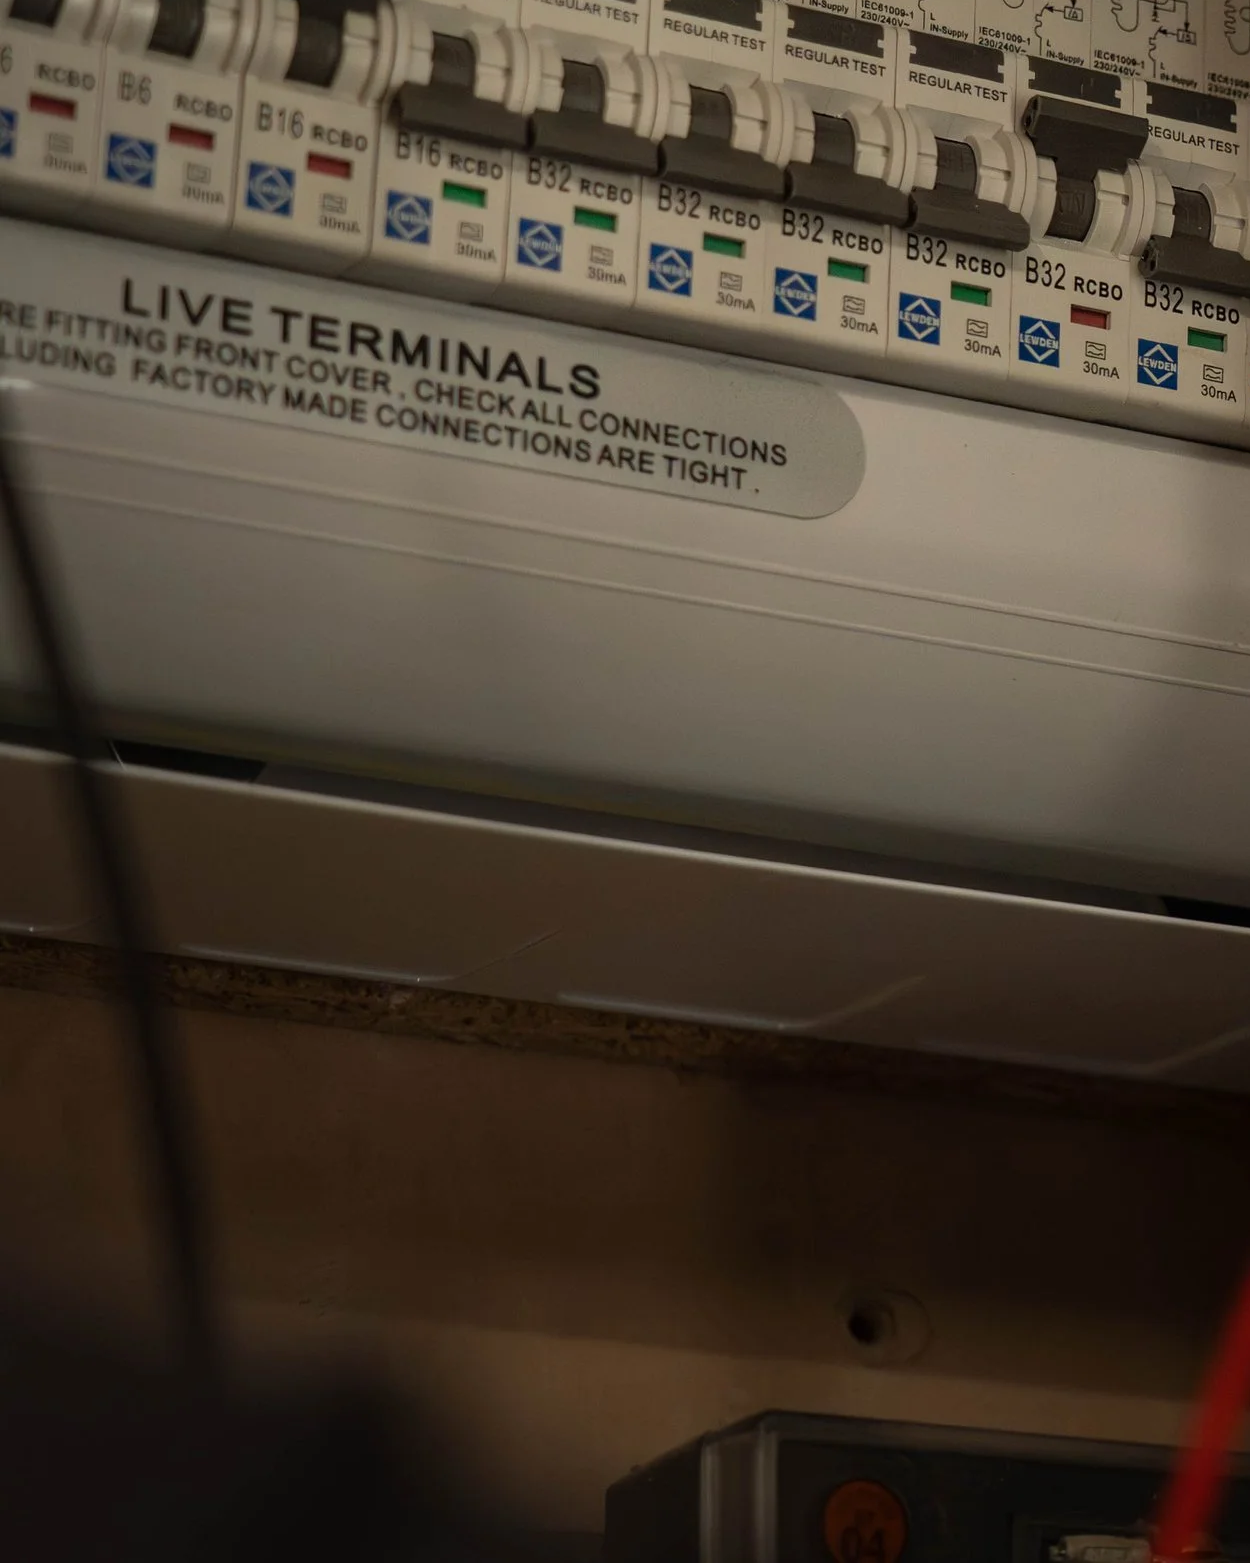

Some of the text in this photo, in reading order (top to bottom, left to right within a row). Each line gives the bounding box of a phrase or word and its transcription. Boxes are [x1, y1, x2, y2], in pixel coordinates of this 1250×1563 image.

[606, 6, 639, 24] TEST
[664, 18, 766, 52] REGULAR TEST
[38, 63, 95, 91] RCBO
[785, 45, 886, 77] REGULAR TEST
[118, 71, 233, 121] B6 RCBO
[910, 71, 1008, 103] REGULAR TEST
[256, 102, 369, 152] B16 RCBO
[1148, 125, 1240, 155] REGULAR TEST
[397, 131, 503, 181] B16 RCBO
[527, 156, 634, 205] B32 RCBO
[658, 184, 760, 230] B32 RCBO
[782, 208, 883, 255] B32 RCBO
[907, 233, 1005, 278] B32 RCBO
[1026, 257, 1122, 300] B32 RCBO
[716, 292, 755, 312] 30mA
[900, 310, 940, 327] LEWDEN
[1145, 281, 1239, 324] B32 RCBO
[122, 279, 600, 400] LIVE TERMINALS
[841, 316, 878, 334] 30mA
[1019, 332, 1058, 349] LEWDEN
[964, 339, 1001, 357] 30mA
[1138, 355, 1177, 373] LEWDEN
[1083, 361, 1120, 379] 30mA
[46, 310, 167, 354] FITTING
[175, 334, 279, 373] FRONT
[415, 378, 515, 417] CHECK
[521, 400, 572, 428] ALL
[580, 408, 787, 466] CONNECTIONS
[1201, 385, 1236, 402] 30mA
[131, 358, 277, 405] FACTORY
[284, 387, 367, 424] MADE
[376, 404, 590, 463] CONNECTIONS
[597, 444, 655, 475] ARE
